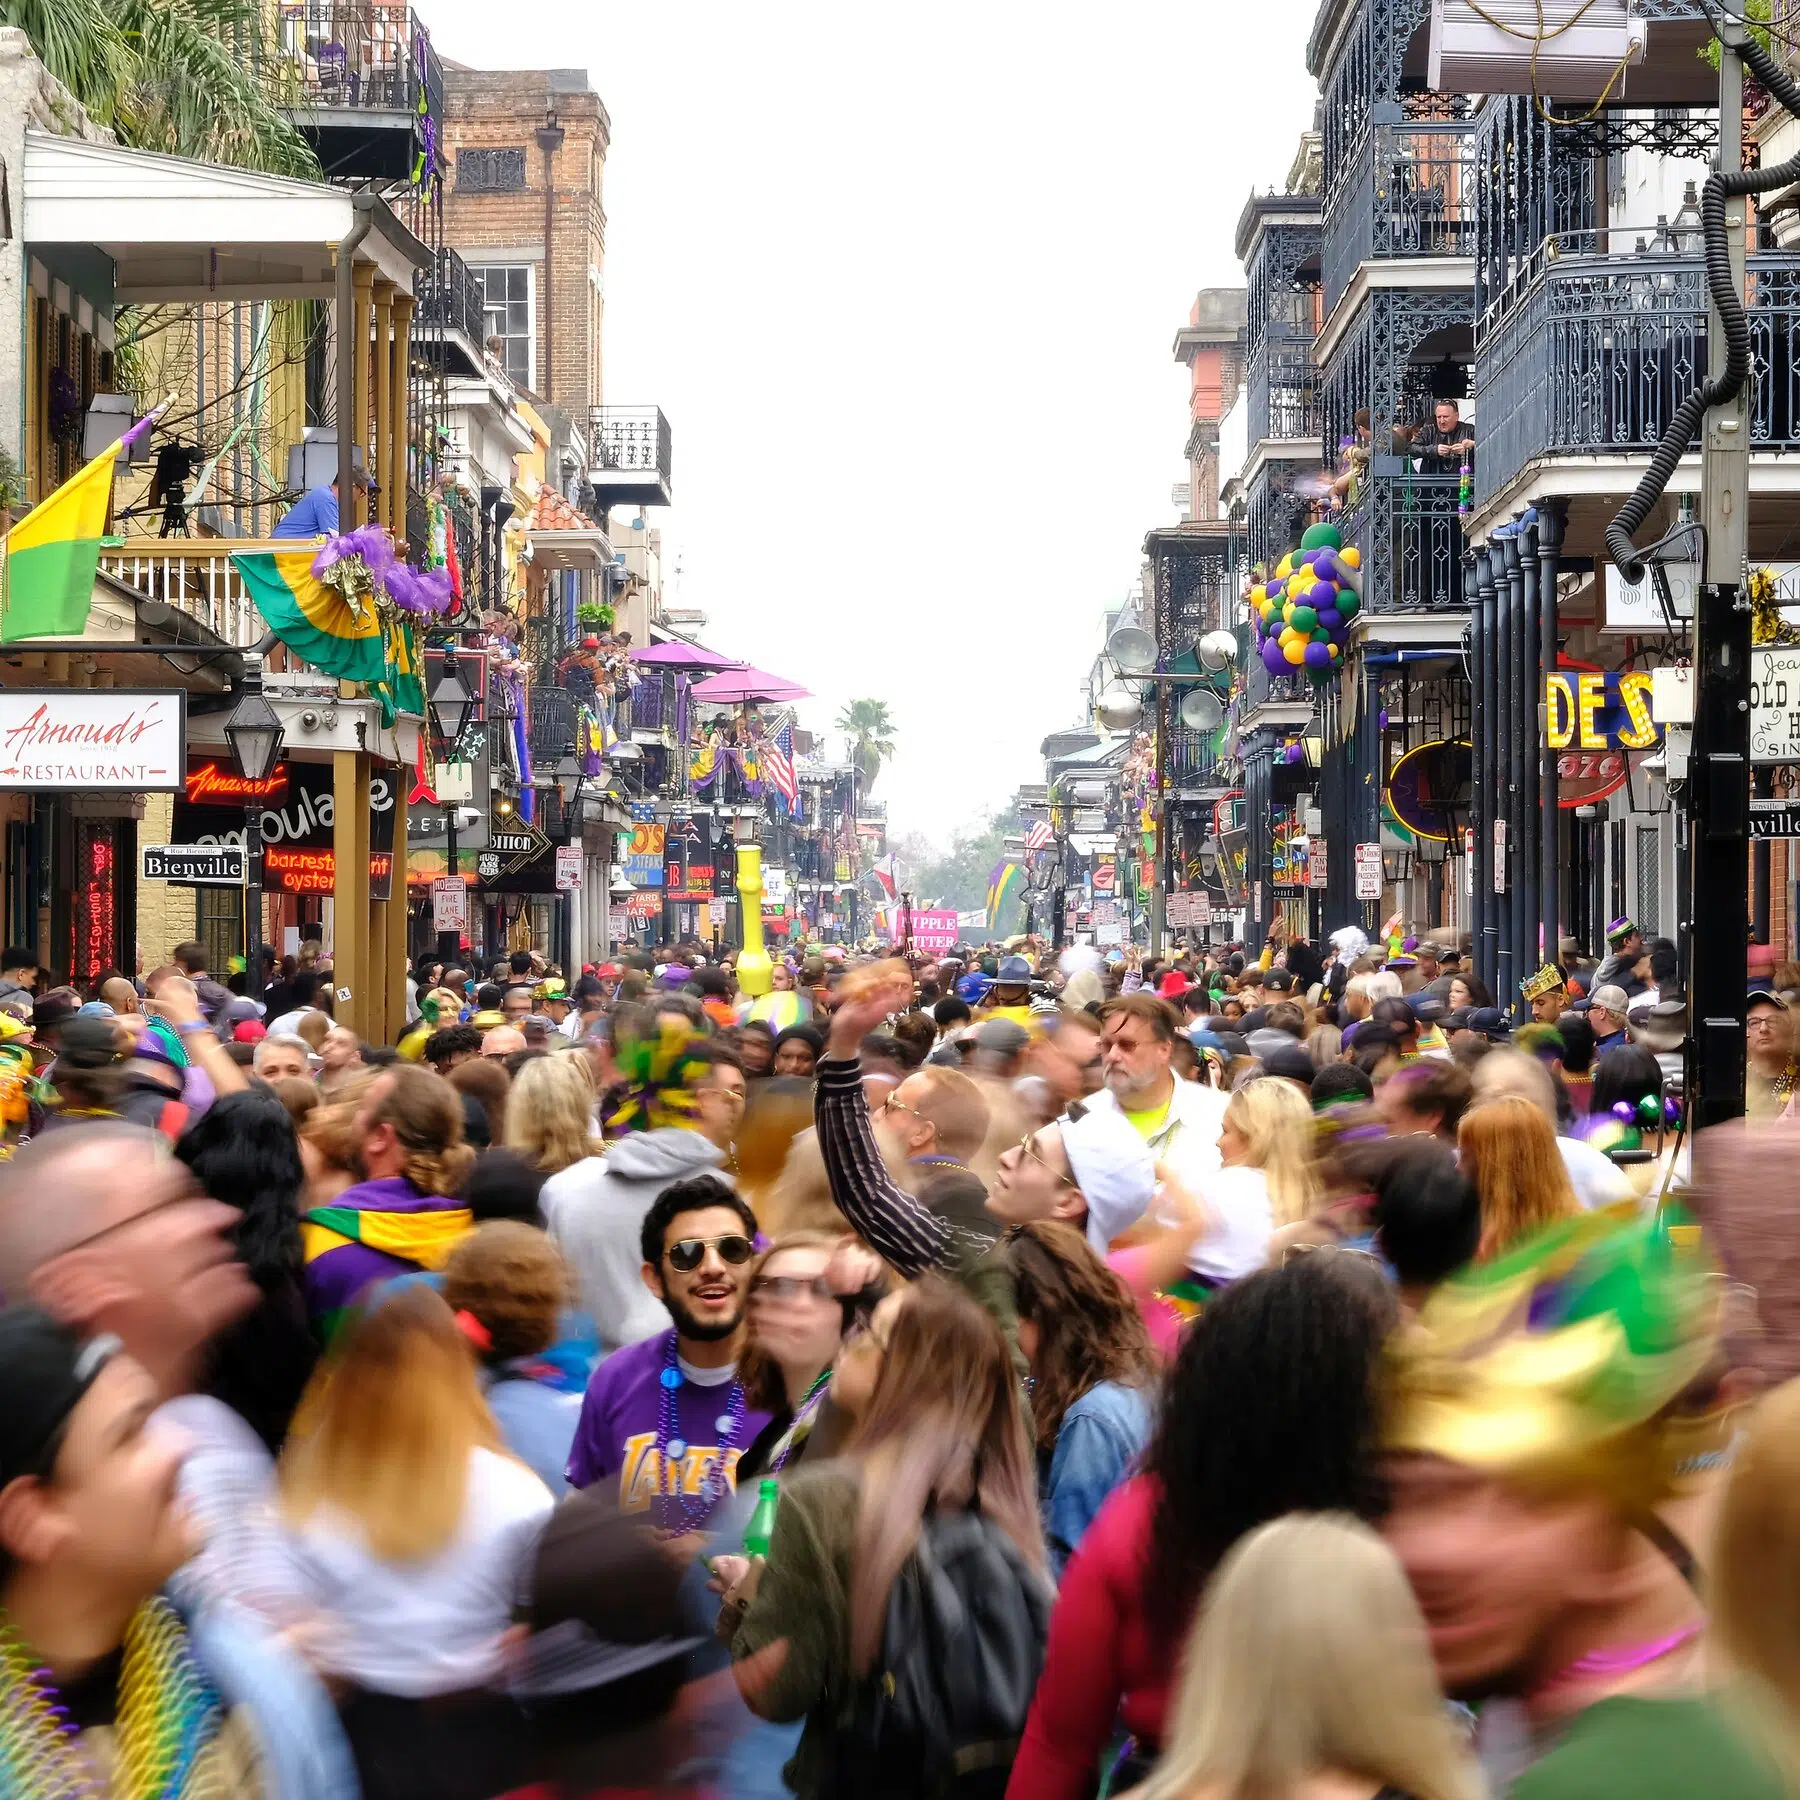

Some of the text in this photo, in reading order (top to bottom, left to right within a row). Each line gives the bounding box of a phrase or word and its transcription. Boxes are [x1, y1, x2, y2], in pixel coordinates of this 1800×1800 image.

[23, 765, 148, 780] RESTAURANT
[146, 857, 241, 876] Bienville
[1314, 857, 1326, 865] AN
[435, 879, 445, 890] NO
[1362, 880, 1375, 888] ZONE
[441, 894, 458, 903] FIRE
[440, 906, 459, 915] LANE
[901, 916, 957, 931] IPPLE
[897, 935, 955, 949] ITTER
[619, 1430, 749, 1517] LAKER
